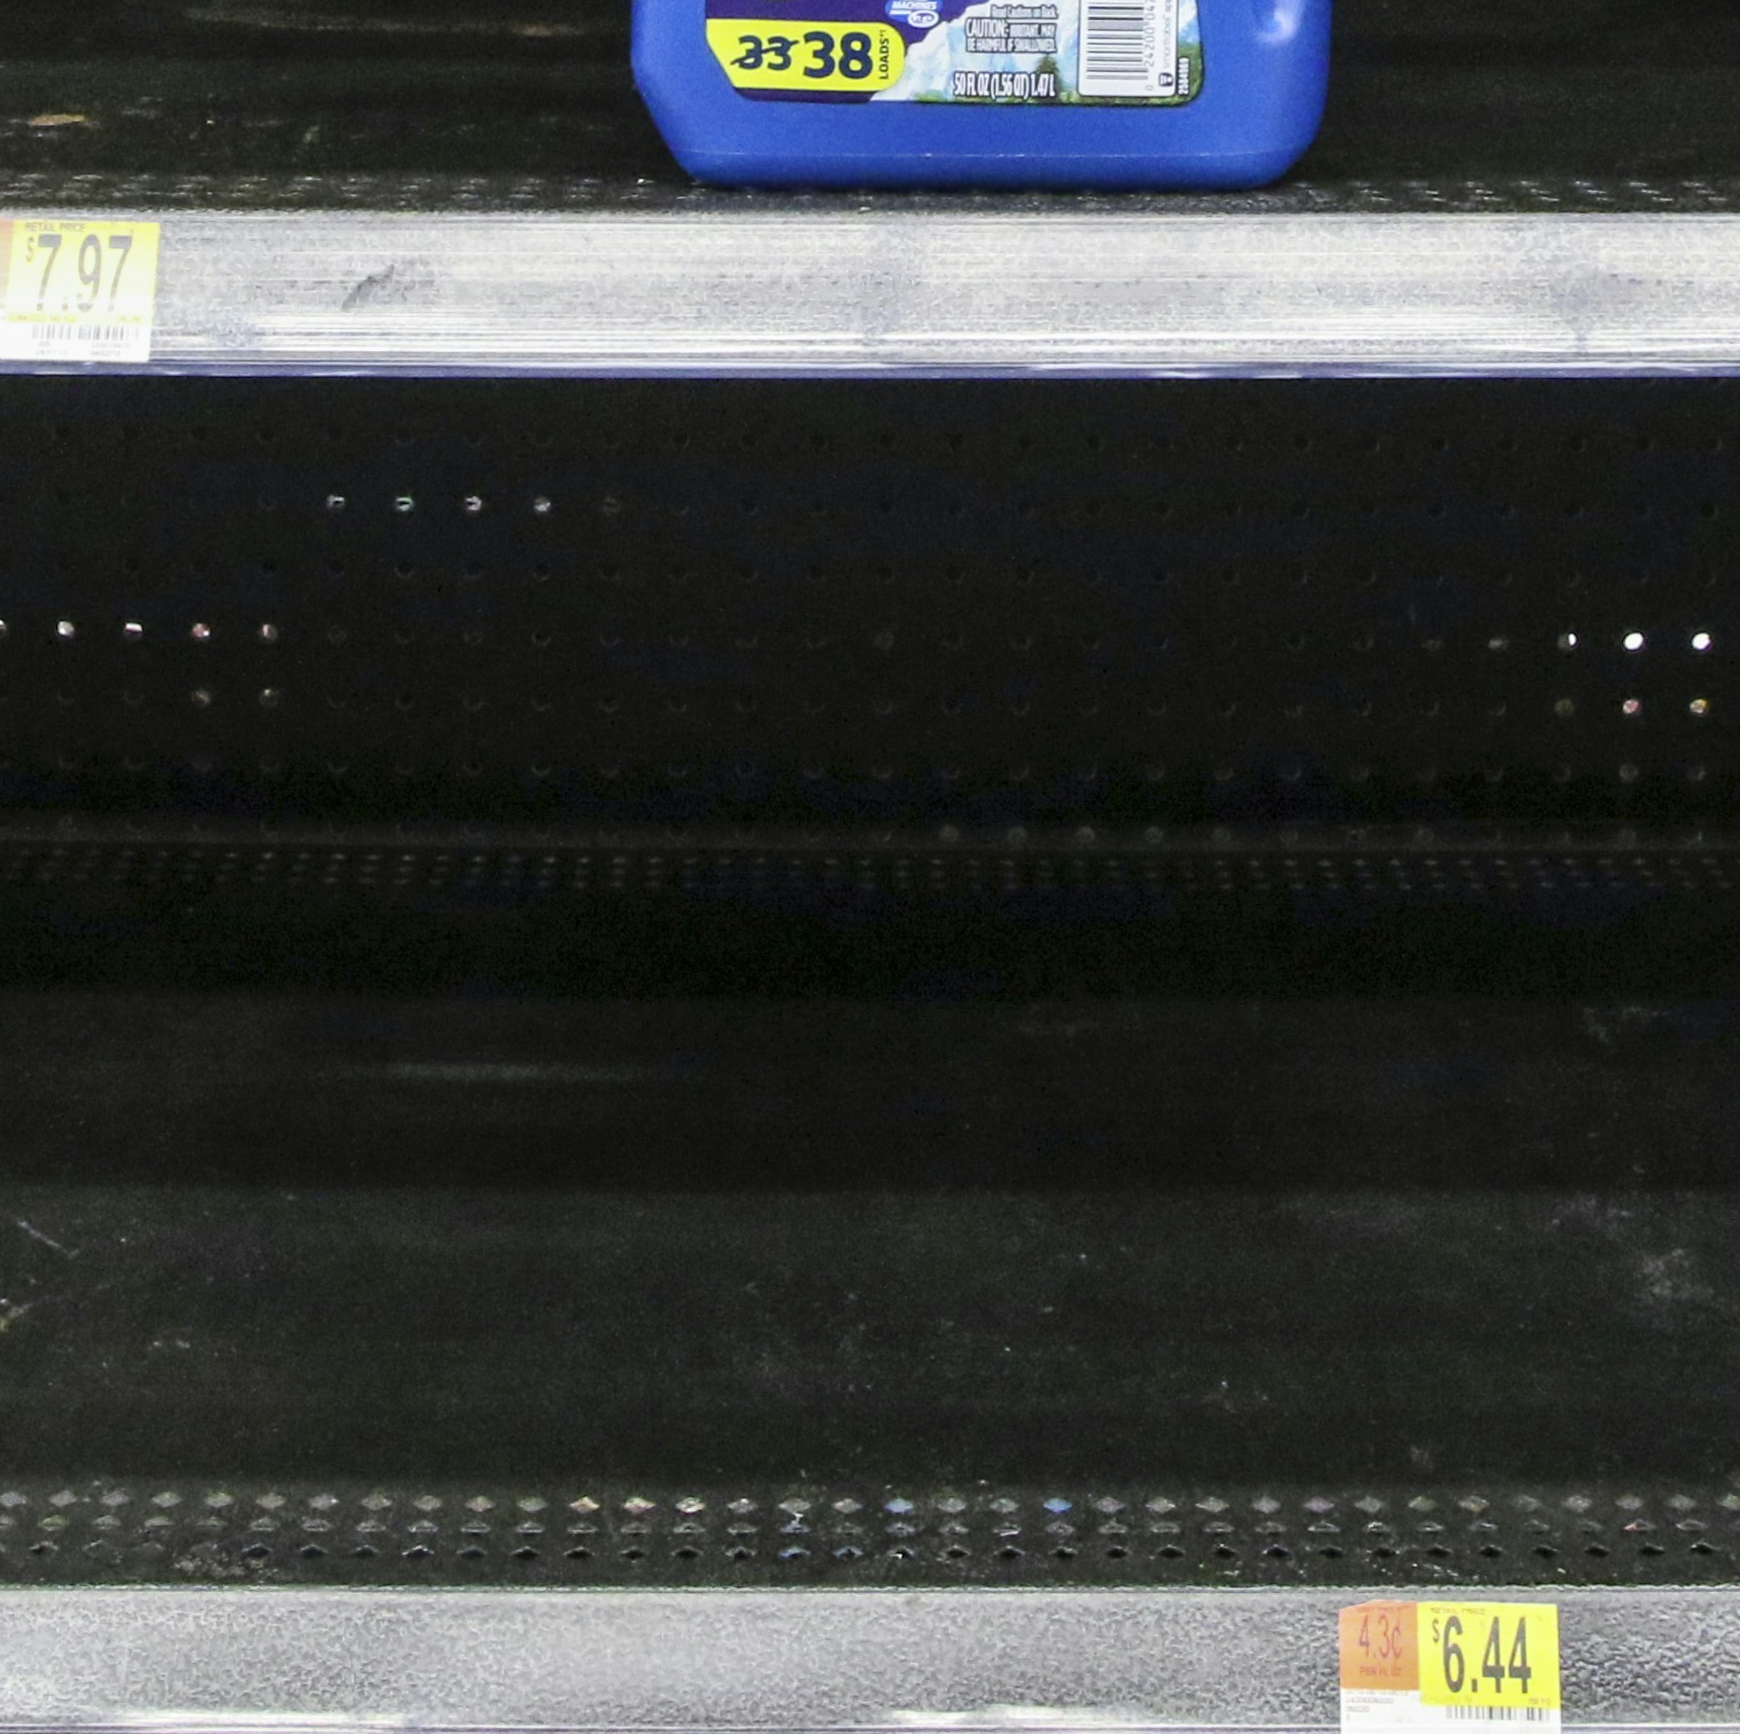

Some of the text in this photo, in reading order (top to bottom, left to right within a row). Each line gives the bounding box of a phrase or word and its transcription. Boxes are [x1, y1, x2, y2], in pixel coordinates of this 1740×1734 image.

[891, 1, 937, 10] MACHINES
[966, 19, 1008, 37] CAUTION:
[803, 31, 874, 80] 38
[954, 73, 966, 96] 50
[967, 73, 977, 96] FL
[978, 73, 990, 96] OZ
[25, 222, 85, 232] RETAIL PRICE
[25, 233, 134, 313] $7.97
[1431, 1615, 1532, 1694] $6.44
